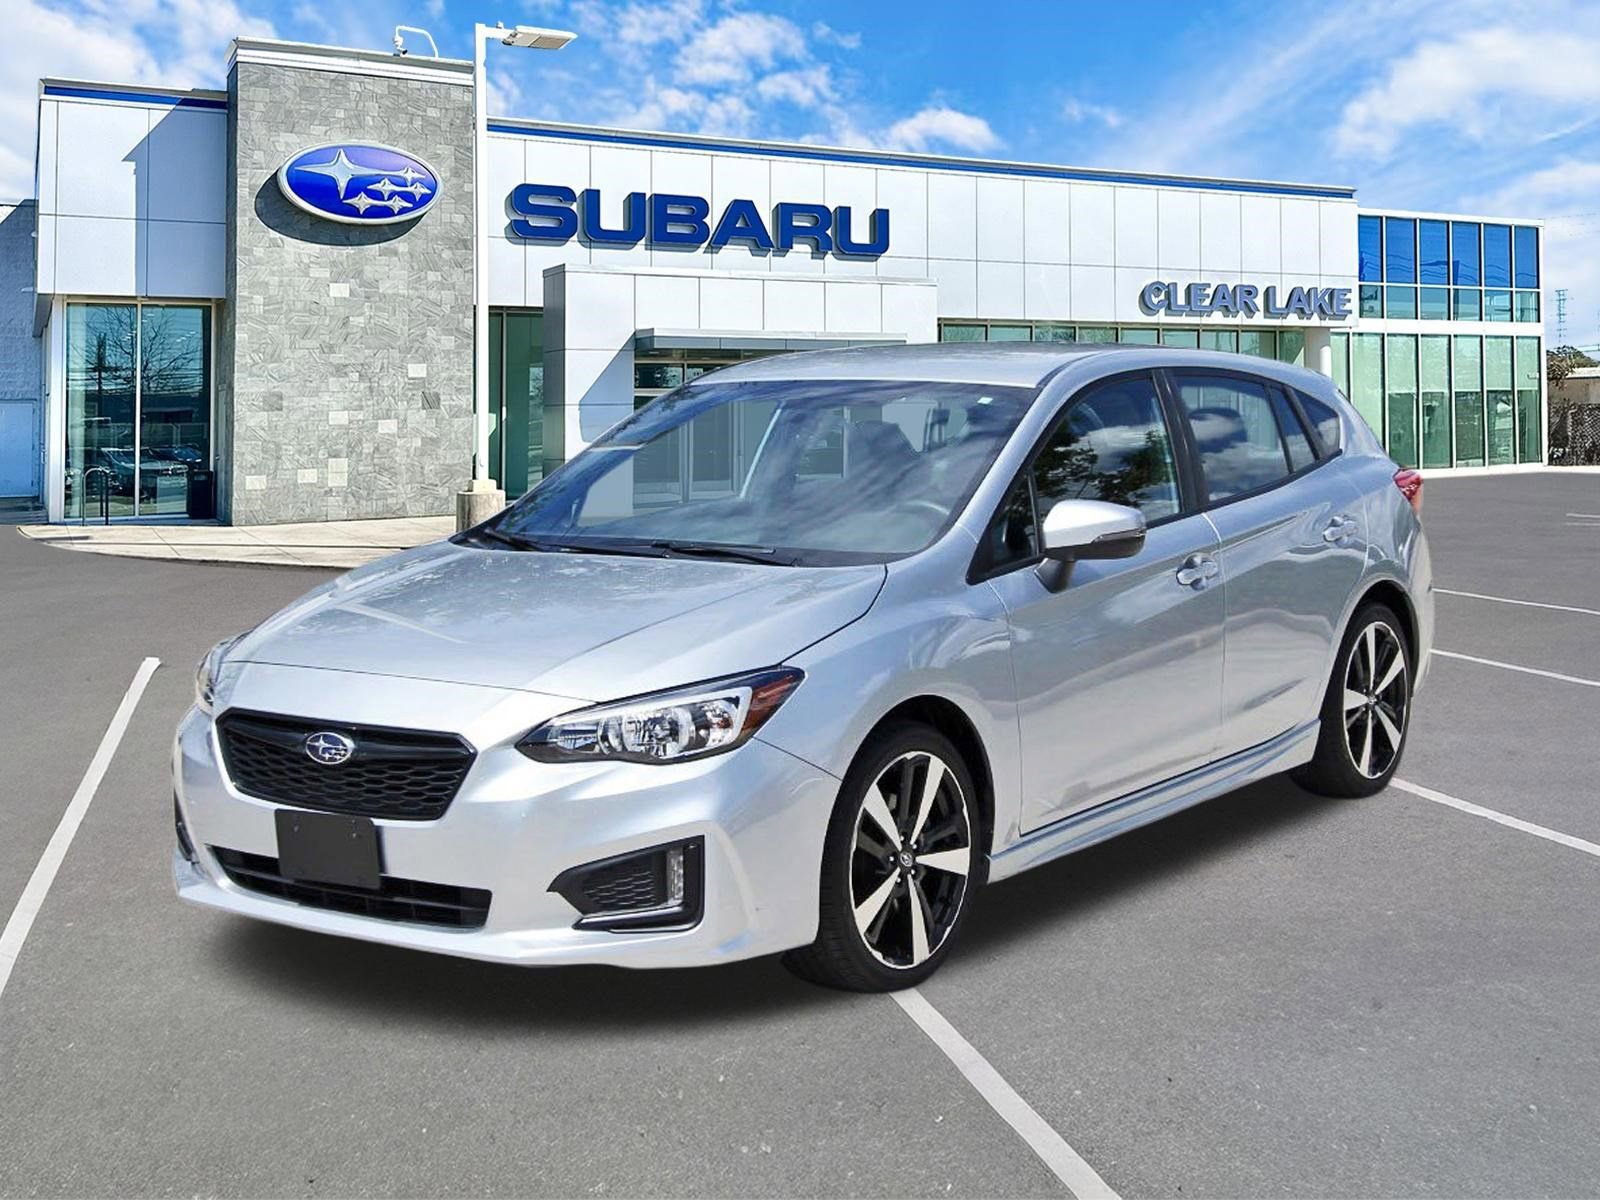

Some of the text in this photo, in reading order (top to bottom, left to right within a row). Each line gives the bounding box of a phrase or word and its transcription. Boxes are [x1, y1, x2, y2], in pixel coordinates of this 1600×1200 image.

[506, 183, 890, 259] SUBARU
[1140, 280, 1353, 320] CLEAR LAKE
